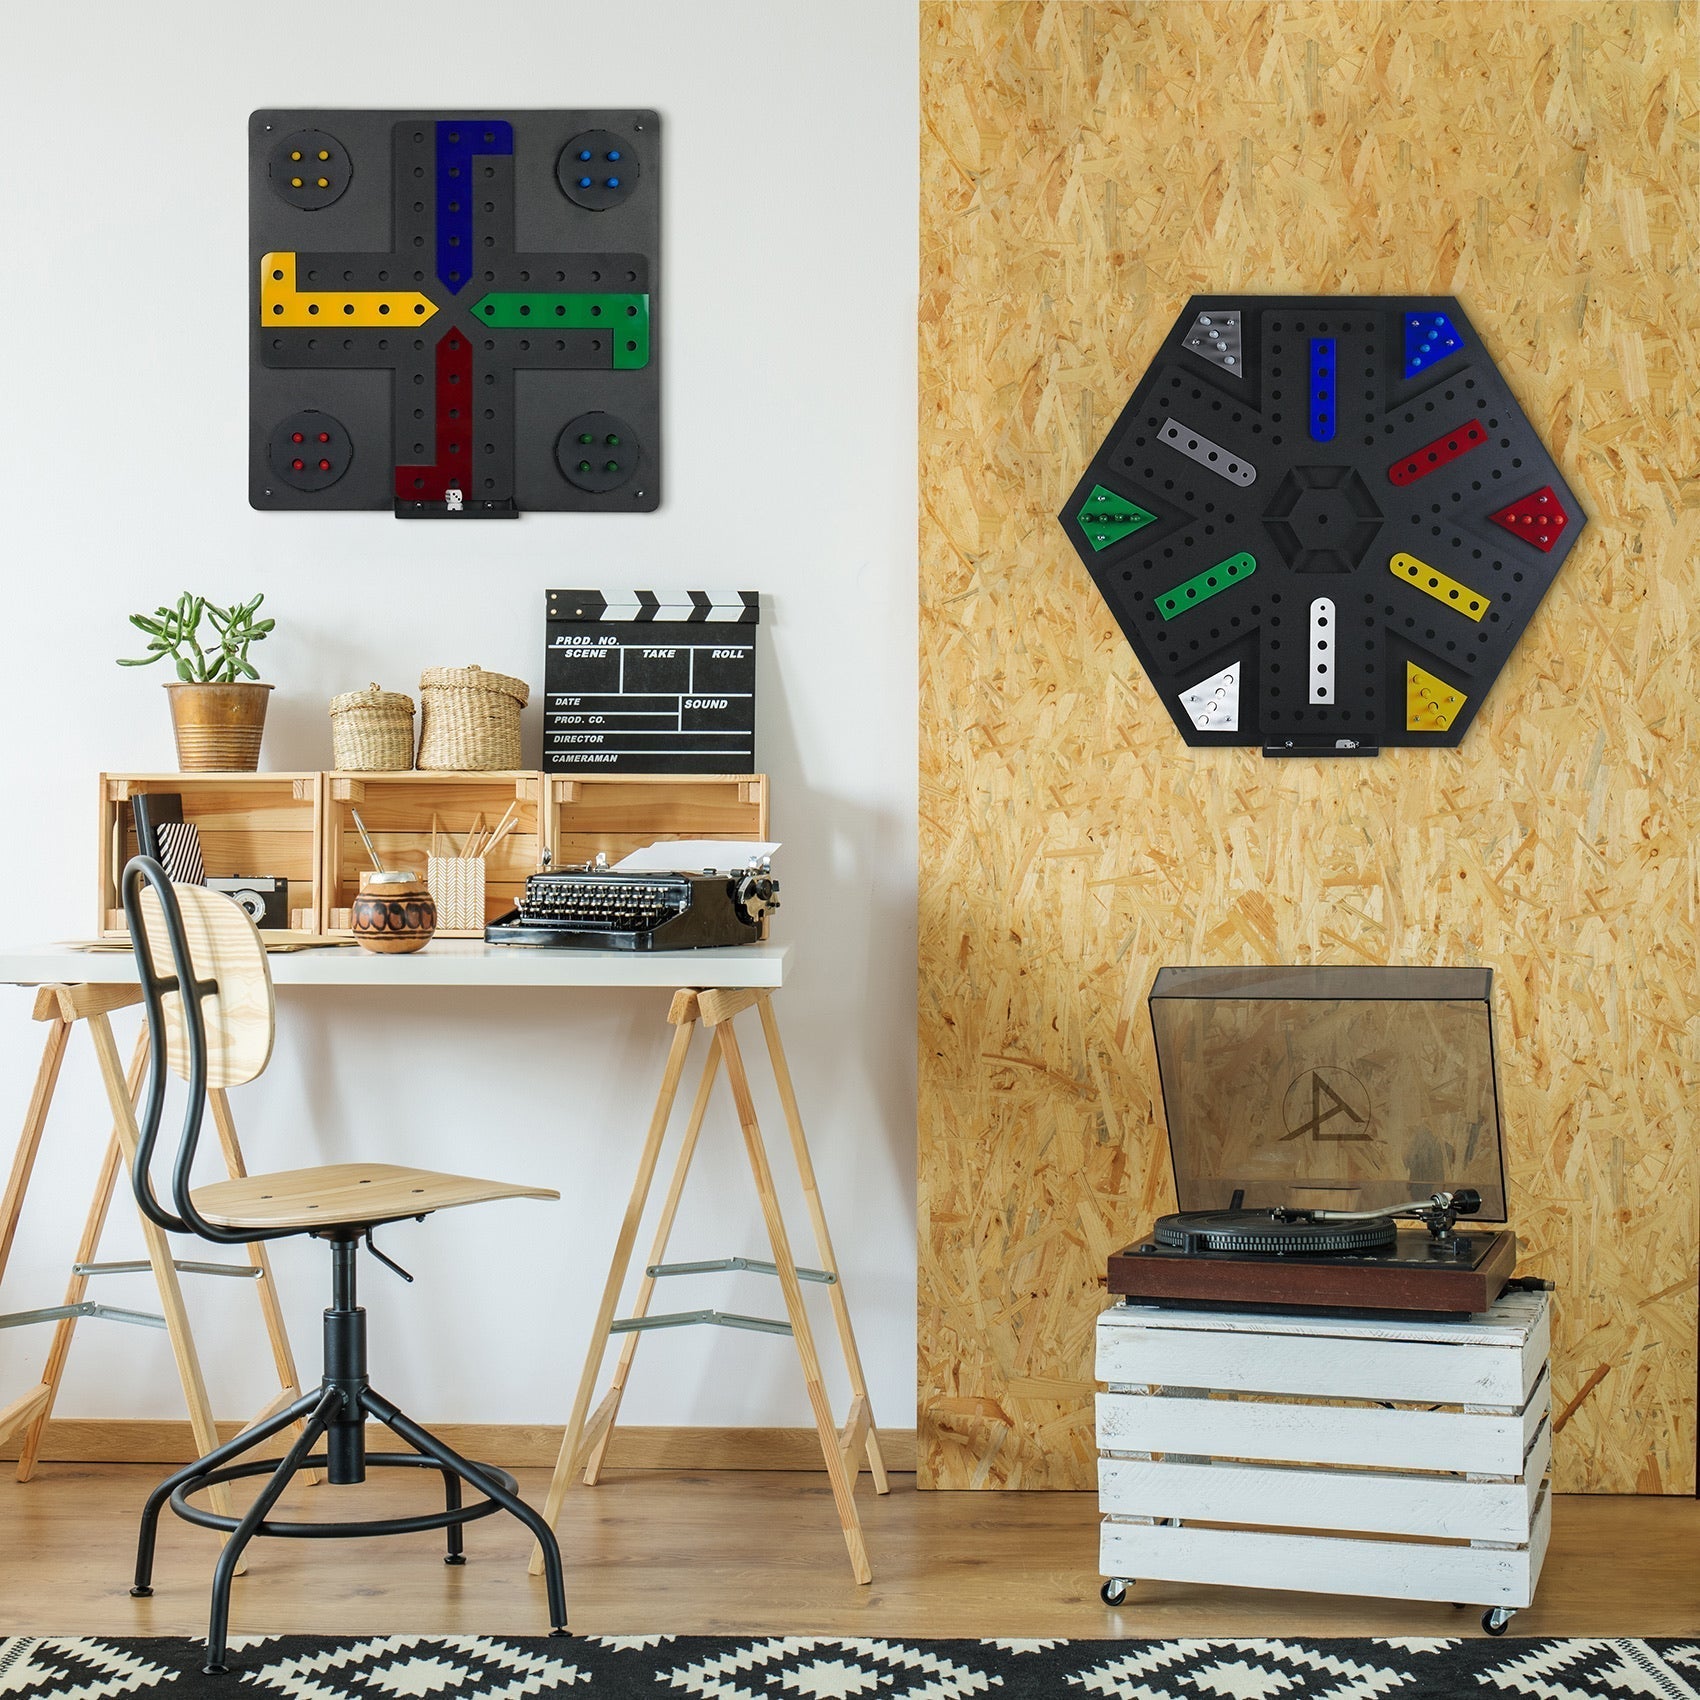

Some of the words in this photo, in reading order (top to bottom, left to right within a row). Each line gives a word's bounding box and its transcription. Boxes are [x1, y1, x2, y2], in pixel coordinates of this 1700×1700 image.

[555, 636, 593, 645] PROD.
[598, 637, 620, 646] NO.
[565, 649, 607, 658] SCENE
[643, 649, 676, 658] TAKE
[712, 650, 744, 659] ROLL
[555, 698, 581, 706] DATE
[684, 699, 728, 709] SOUND
[554, 716, 585, 724] PROD.
[588, 716, 606, 724] CO.
[553, 735, 604, 743] DIRECTOR
[552, 754, 618, 763] CAMERAMAN
